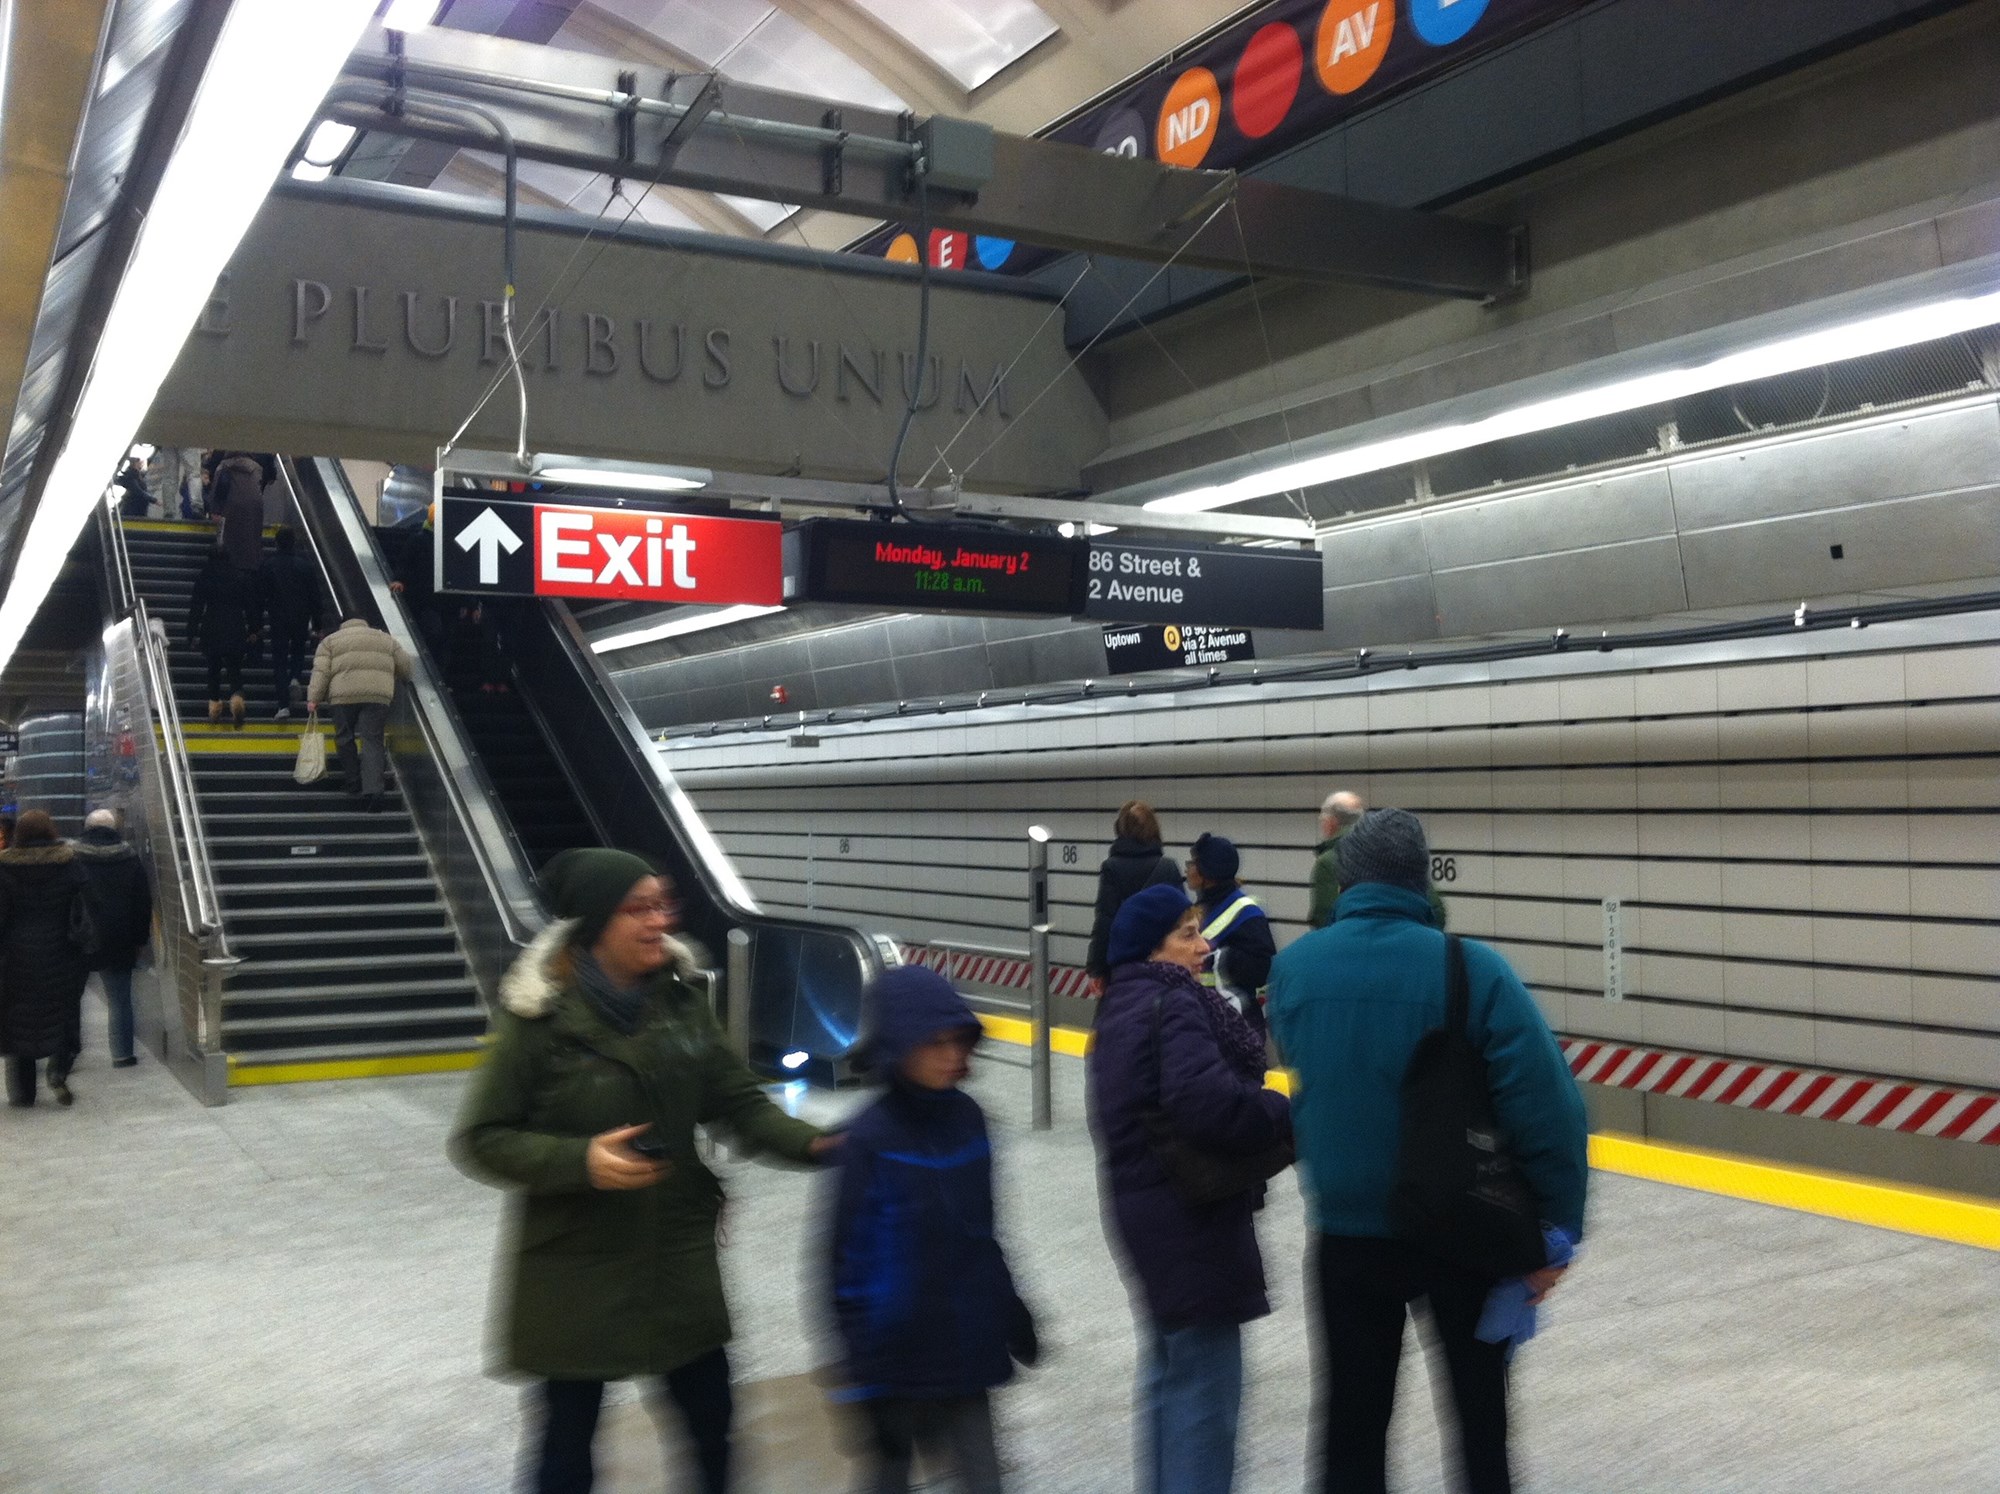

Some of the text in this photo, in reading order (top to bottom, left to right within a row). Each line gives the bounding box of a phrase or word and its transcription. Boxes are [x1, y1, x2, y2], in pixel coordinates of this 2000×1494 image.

[1165, 96, 1210, 152] ND
[1327, 3, 1380, 68] AV
[293, 277, 731, 389] PLURIBUS
[773, 335, 1012, 419] UNUM
[540, 511, 697, 589] Exit
[875, 541, 1030, 575] Monday, January 2
[1088, 551, 1202, 578] 86 Street &
[914, 570, 986, 593] 11:28 a.m.
[1088, 578, 1184, 603] 2 Avenue
[1104, 632, 1141, 650] Uptown
[1167, 631, 1177, 645] Q
[1182, 632, 1246, 651] via 2 Avenue
[1184, 649, 1228, 665] all times
[840, 838, 850, 854] 86
[1062, 845, 1078, 864] 86
[1431, 857, 1457, 882] 86
